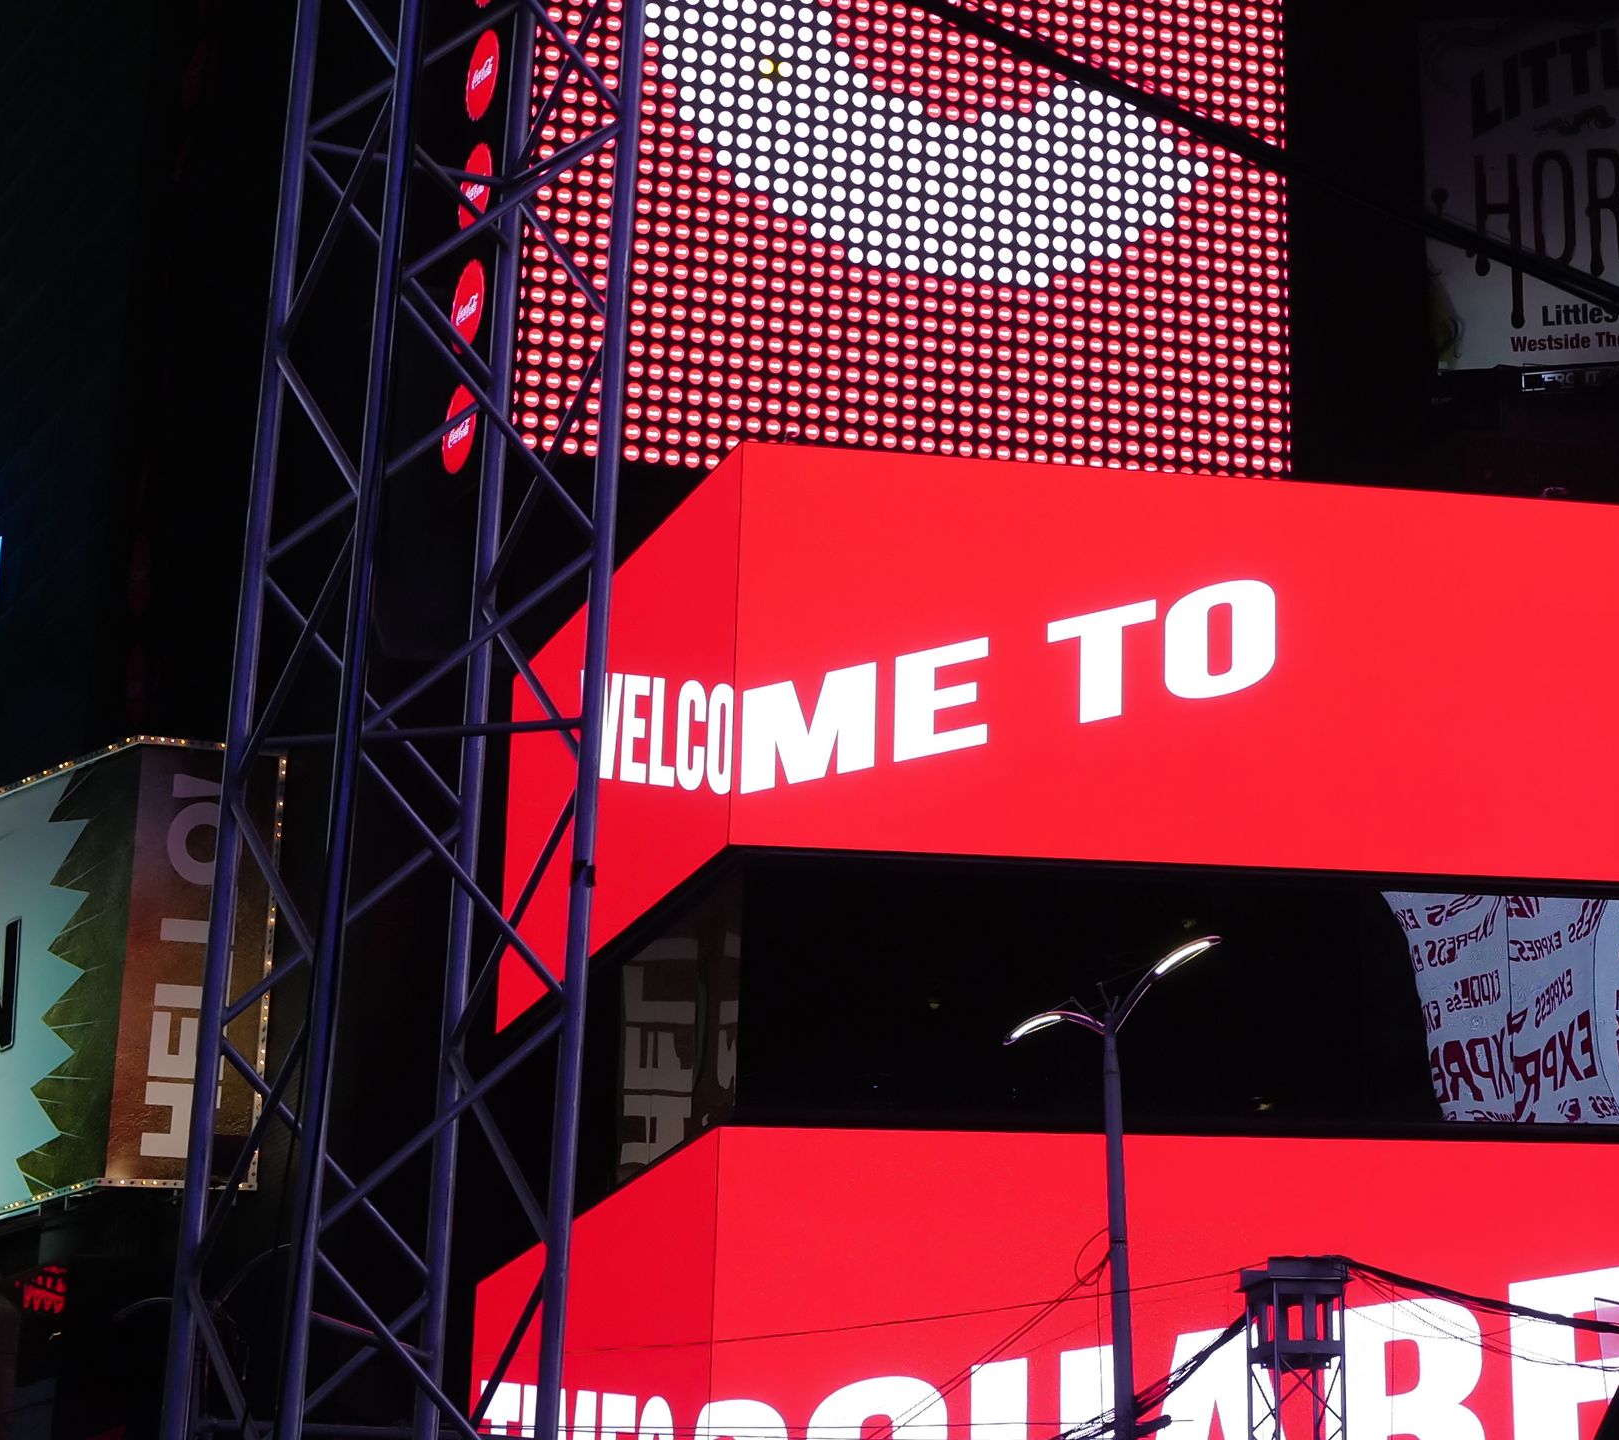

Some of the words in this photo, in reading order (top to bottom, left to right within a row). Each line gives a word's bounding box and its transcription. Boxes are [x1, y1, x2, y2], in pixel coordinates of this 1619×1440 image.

[1511, 334, 1590, 352] Westside
[581, 636, 989, 795] WELCOME
[1046, 578, 1277, 725] TO
